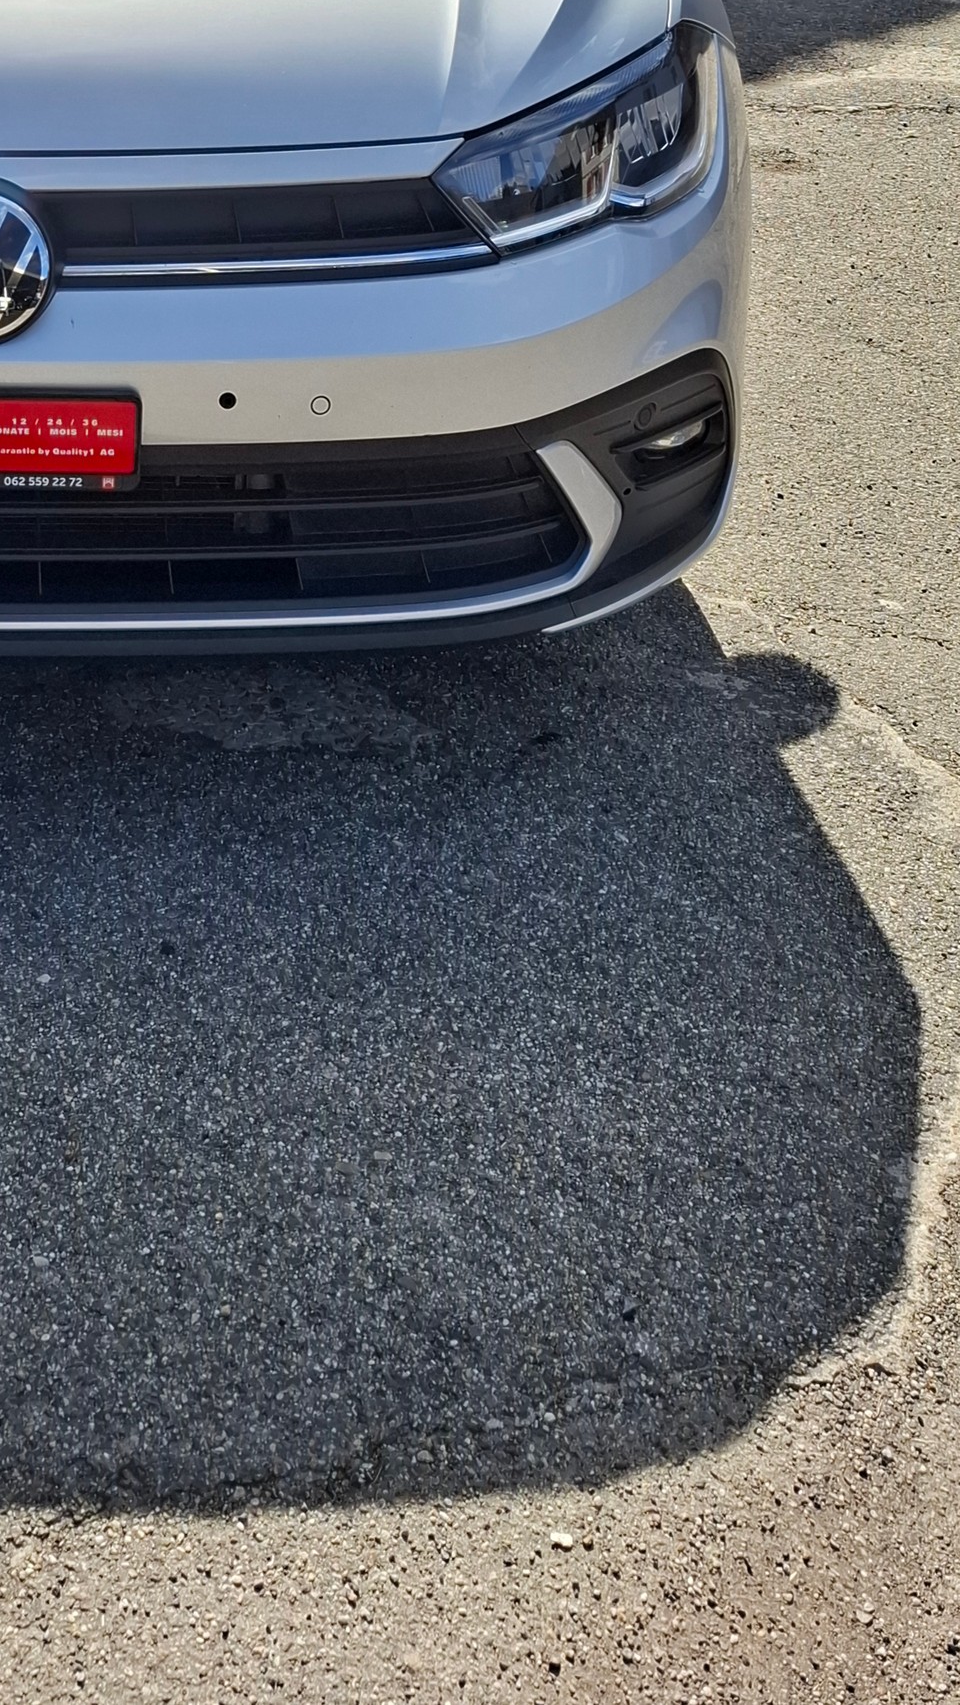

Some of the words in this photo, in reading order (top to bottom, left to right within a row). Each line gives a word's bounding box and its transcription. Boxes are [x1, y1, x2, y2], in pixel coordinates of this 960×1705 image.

[11, 417, 28, 426] 12
[47, 418, 63, 426] 24
[49, 428, 77, 436] MOIS
[96, 429, 124, 437] MESI
[38, 447, 50, 456] by
[100, 448, 115, 456] AG
[3, 476, 26, 486] 062
[28, 476, 50, 487] 559
[52, 477, 66, 487] 22
[69, 477, 83, 487] 72
